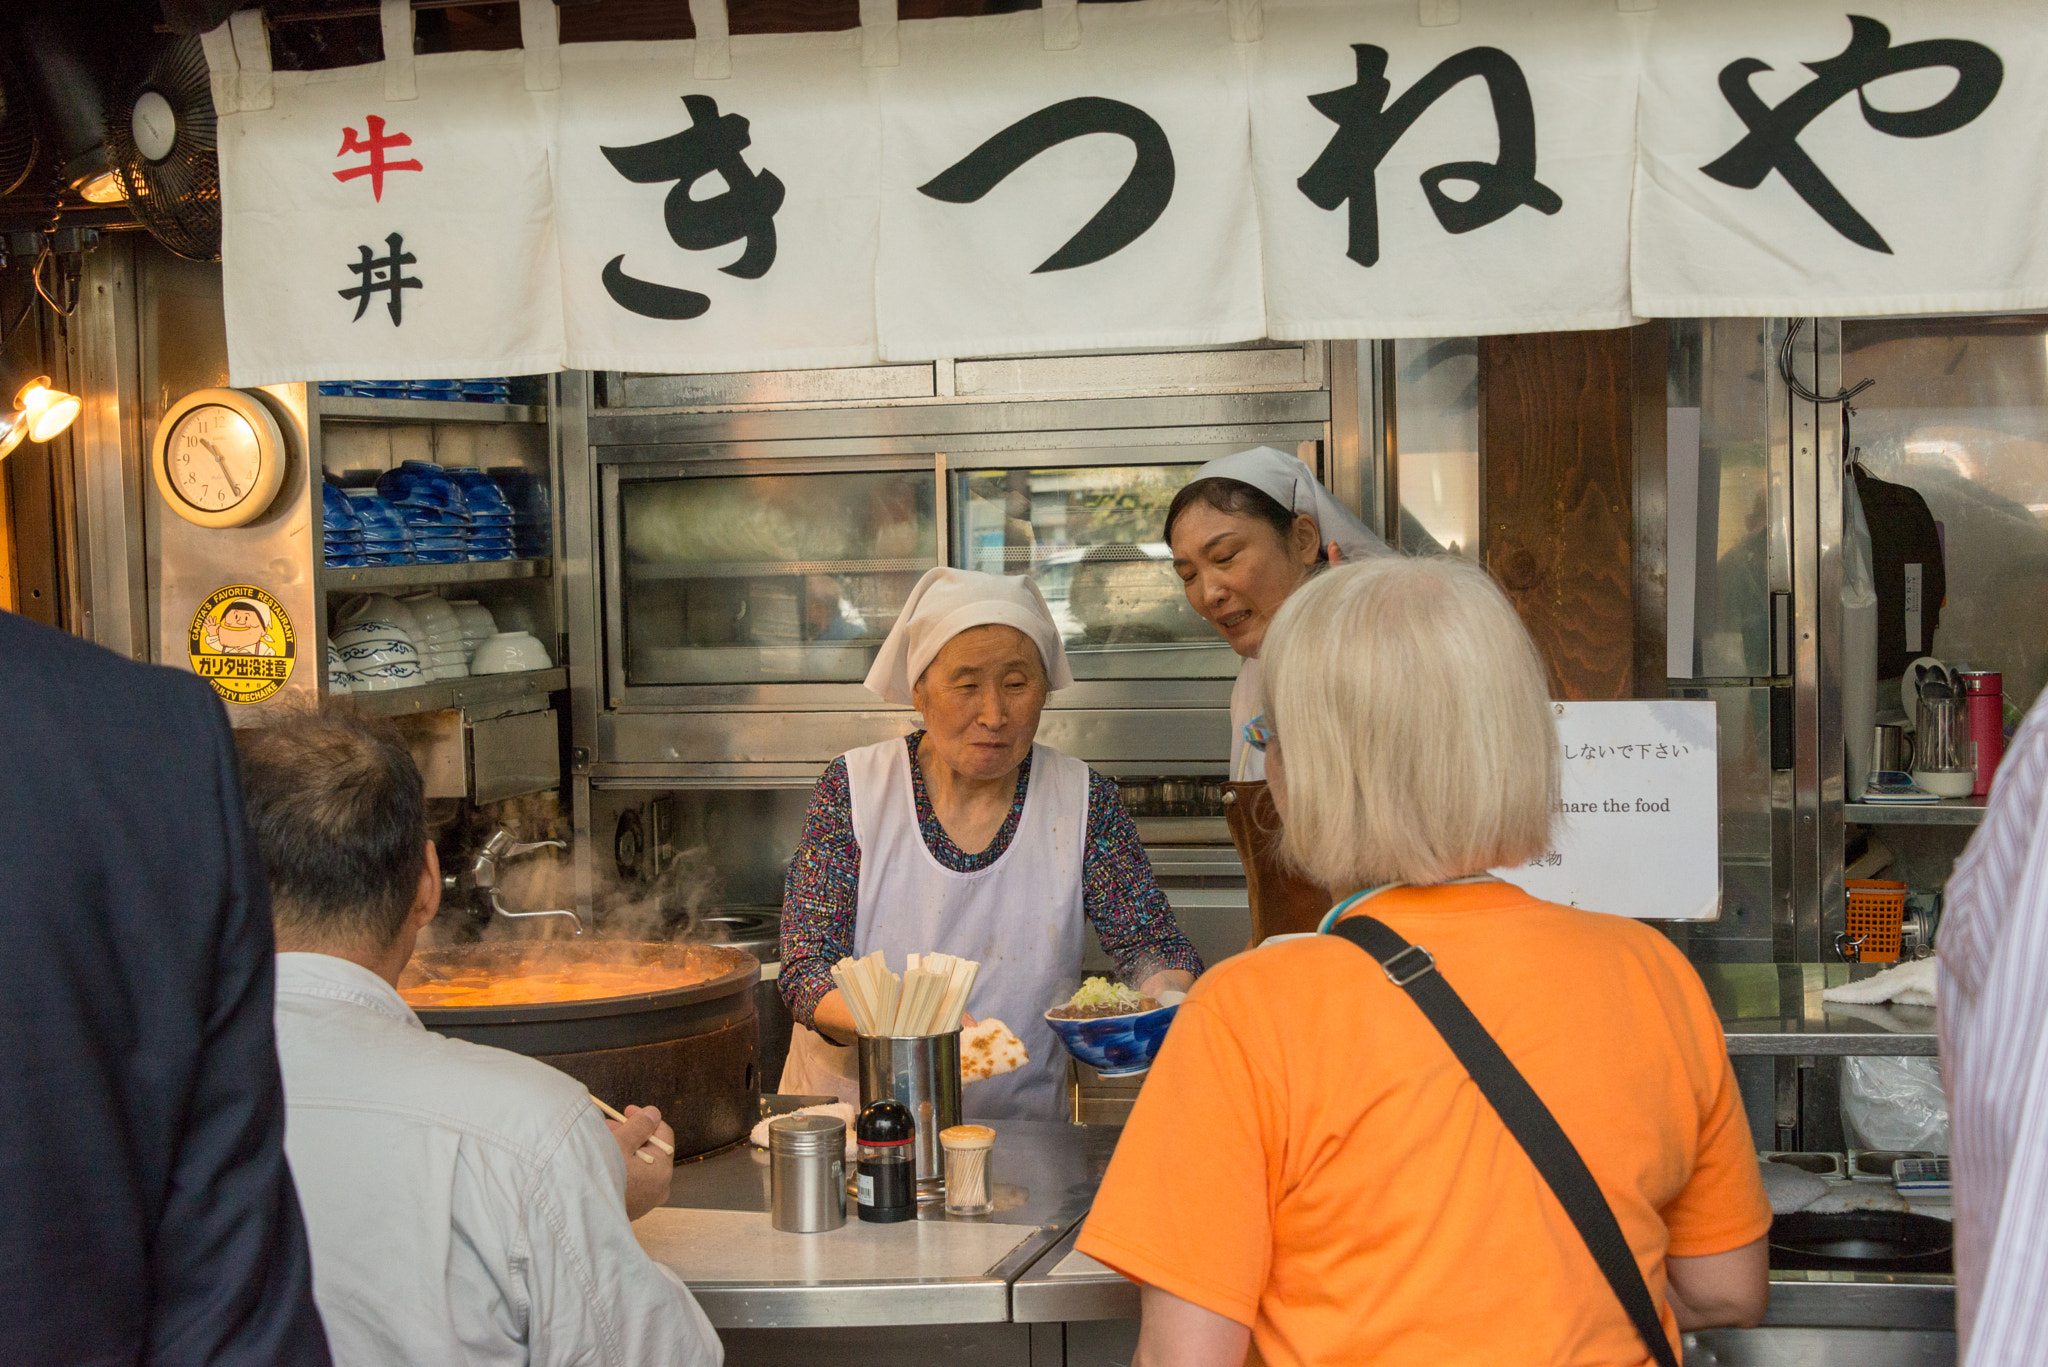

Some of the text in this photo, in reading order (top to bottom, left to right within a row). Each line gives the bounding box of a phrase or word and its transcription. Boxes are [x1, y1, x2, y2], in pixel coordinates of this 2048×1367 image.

[600, 15, 2003, 320] きつねや
[333, 115, 423, 327] 牛丼
[198, 421, 208, 433] 11
[215, 415, 225, 429] 12
[186, 436, 198, 447] 10
[182, 453, 190, 466] 9
[188, 472, 196, 484] 8
[202, 484, 208, 496] 7
[217, 489, 225, 501] 6
[192, 588, 294, 643] GARITA'S FAVORITE RESTAURANT
[199, 658, 286, 677] ガリタ出没注意
[238, 681, 278, 701] MECHAIKE
[1563, 743, 1690, 760] しないで下さい
[1603, 798, 1631, 813] the
[1635, 798, 1671, 813] food
